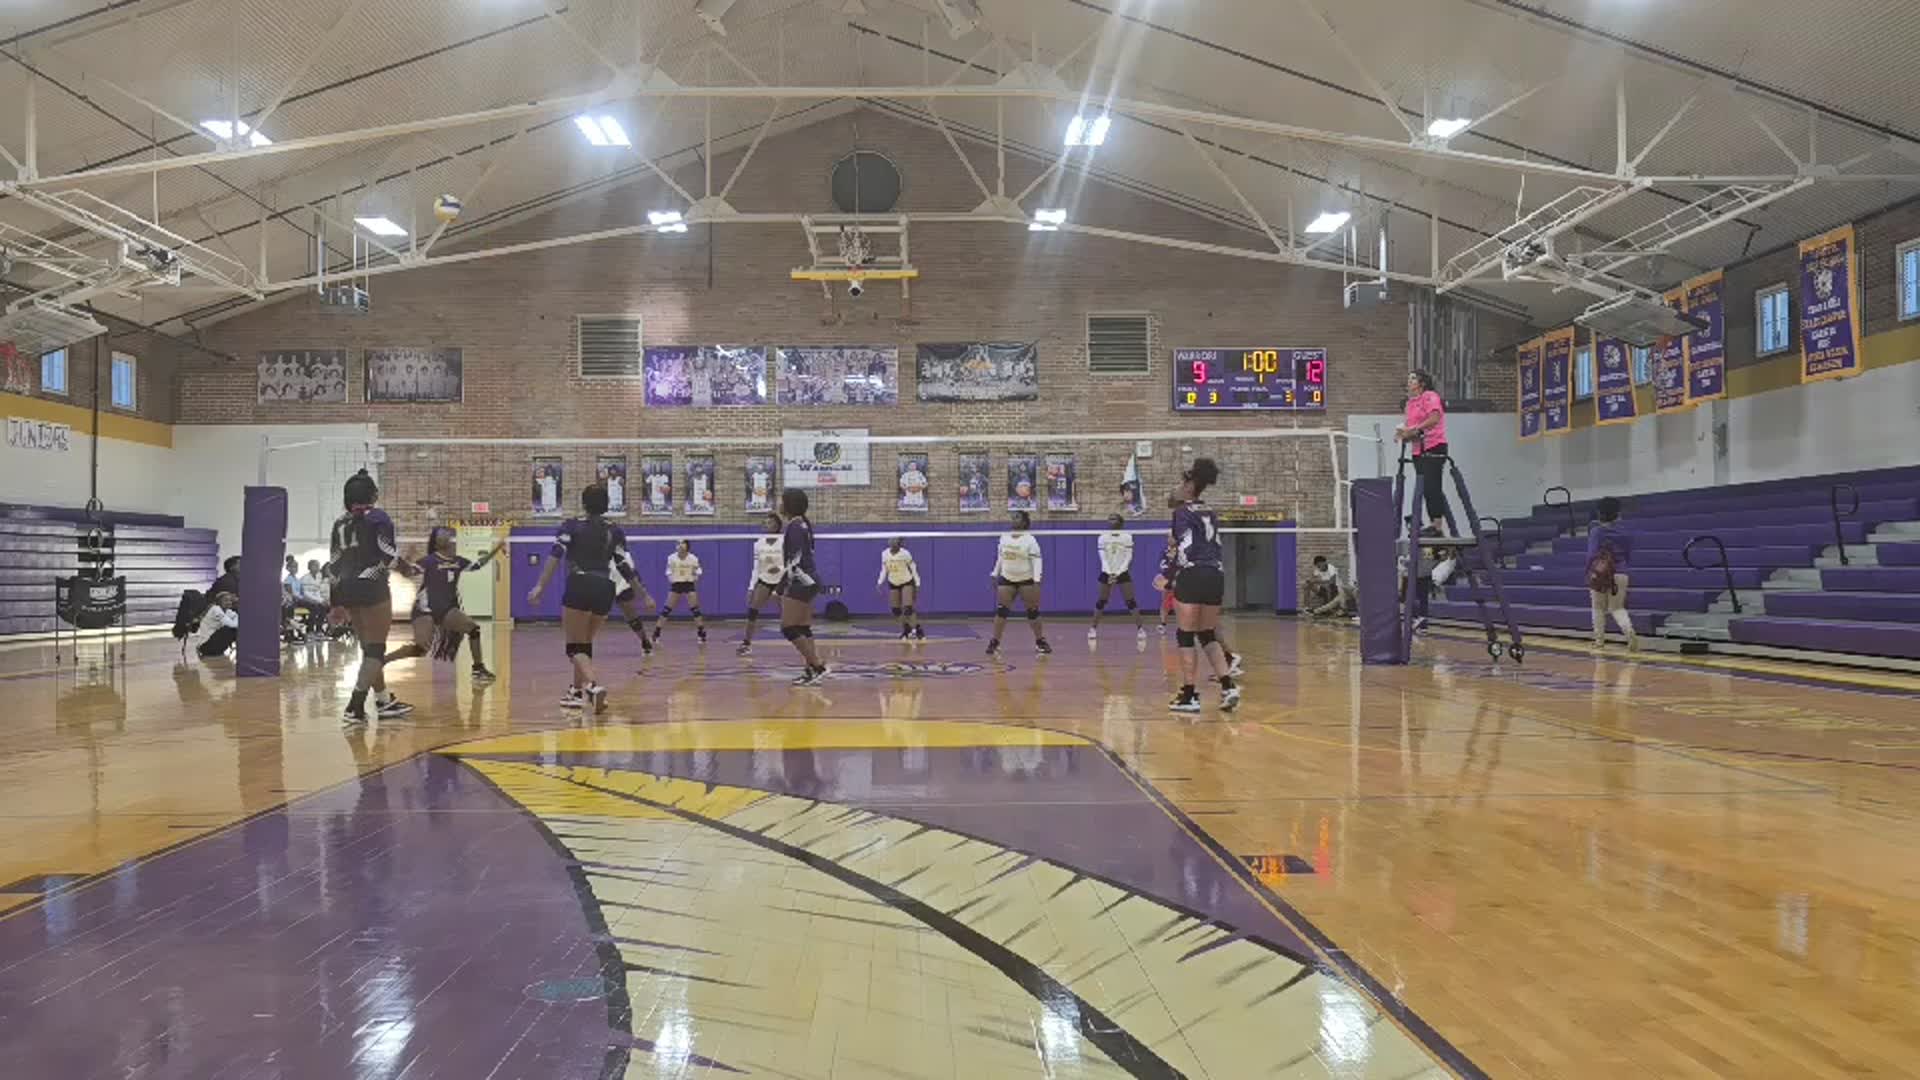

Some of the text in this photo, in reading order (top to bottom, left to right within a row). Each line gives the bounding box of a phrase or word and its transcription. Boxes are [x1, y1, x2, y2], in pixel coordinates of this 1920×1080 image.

[1193, 360, 1206, 383] 9
[1243, 350, 1277, 373] 1:00
[1305, 360, 1323, 382] 12
